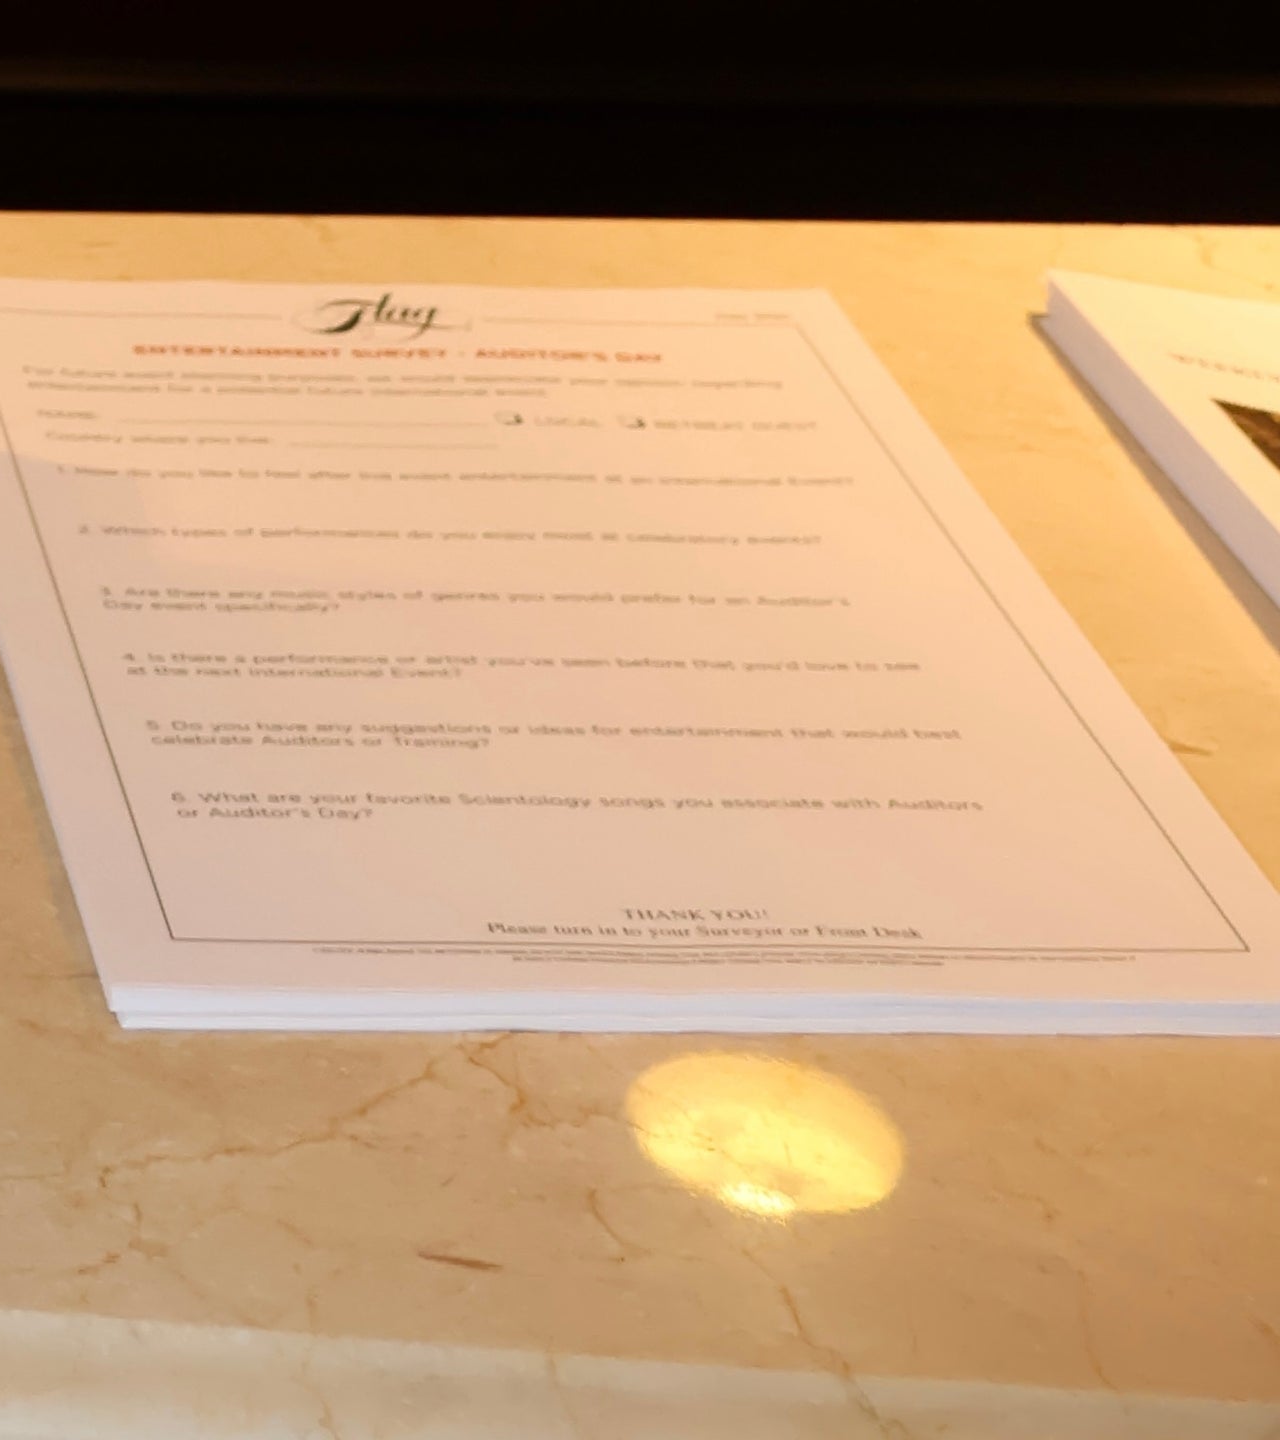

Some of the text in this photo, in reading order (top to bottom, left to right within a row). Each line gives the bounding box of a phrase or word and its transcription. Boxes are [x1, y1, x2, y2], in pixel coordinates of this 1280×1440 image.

[131, 345, 340, 358] ENTERTAINMENT
[351, 348, 446, 359] SURVEY
[614, 352, 662, 363] DAY
[197, 792, 259, 803] What
[267, 794, 302, 804] are
[309, 794, 358, 807] your
[366, 794, 452, 805] favorite
[457, 795, 591, 807] Scientology
[599, 797, 666, 809] songs
[671, 798, 714, 809] you
[720, 799, 826, 809] associate
[831, 799, 881, 809] with
[887, 799, 985, 811] Auditors
[176, 807, 374, 820] or Auditor's Day?
[622, 909, 706, 921] THANK
[487, 922, 548, 935] Please
[553, 926, 594, 935] turn
[597, 927, 619, 936] in
[622, 927, 643, 937] to
[648, 928, 691, 940] your
[789, 927, 810, 937] or
[871, 927, 925, 939] Desk
